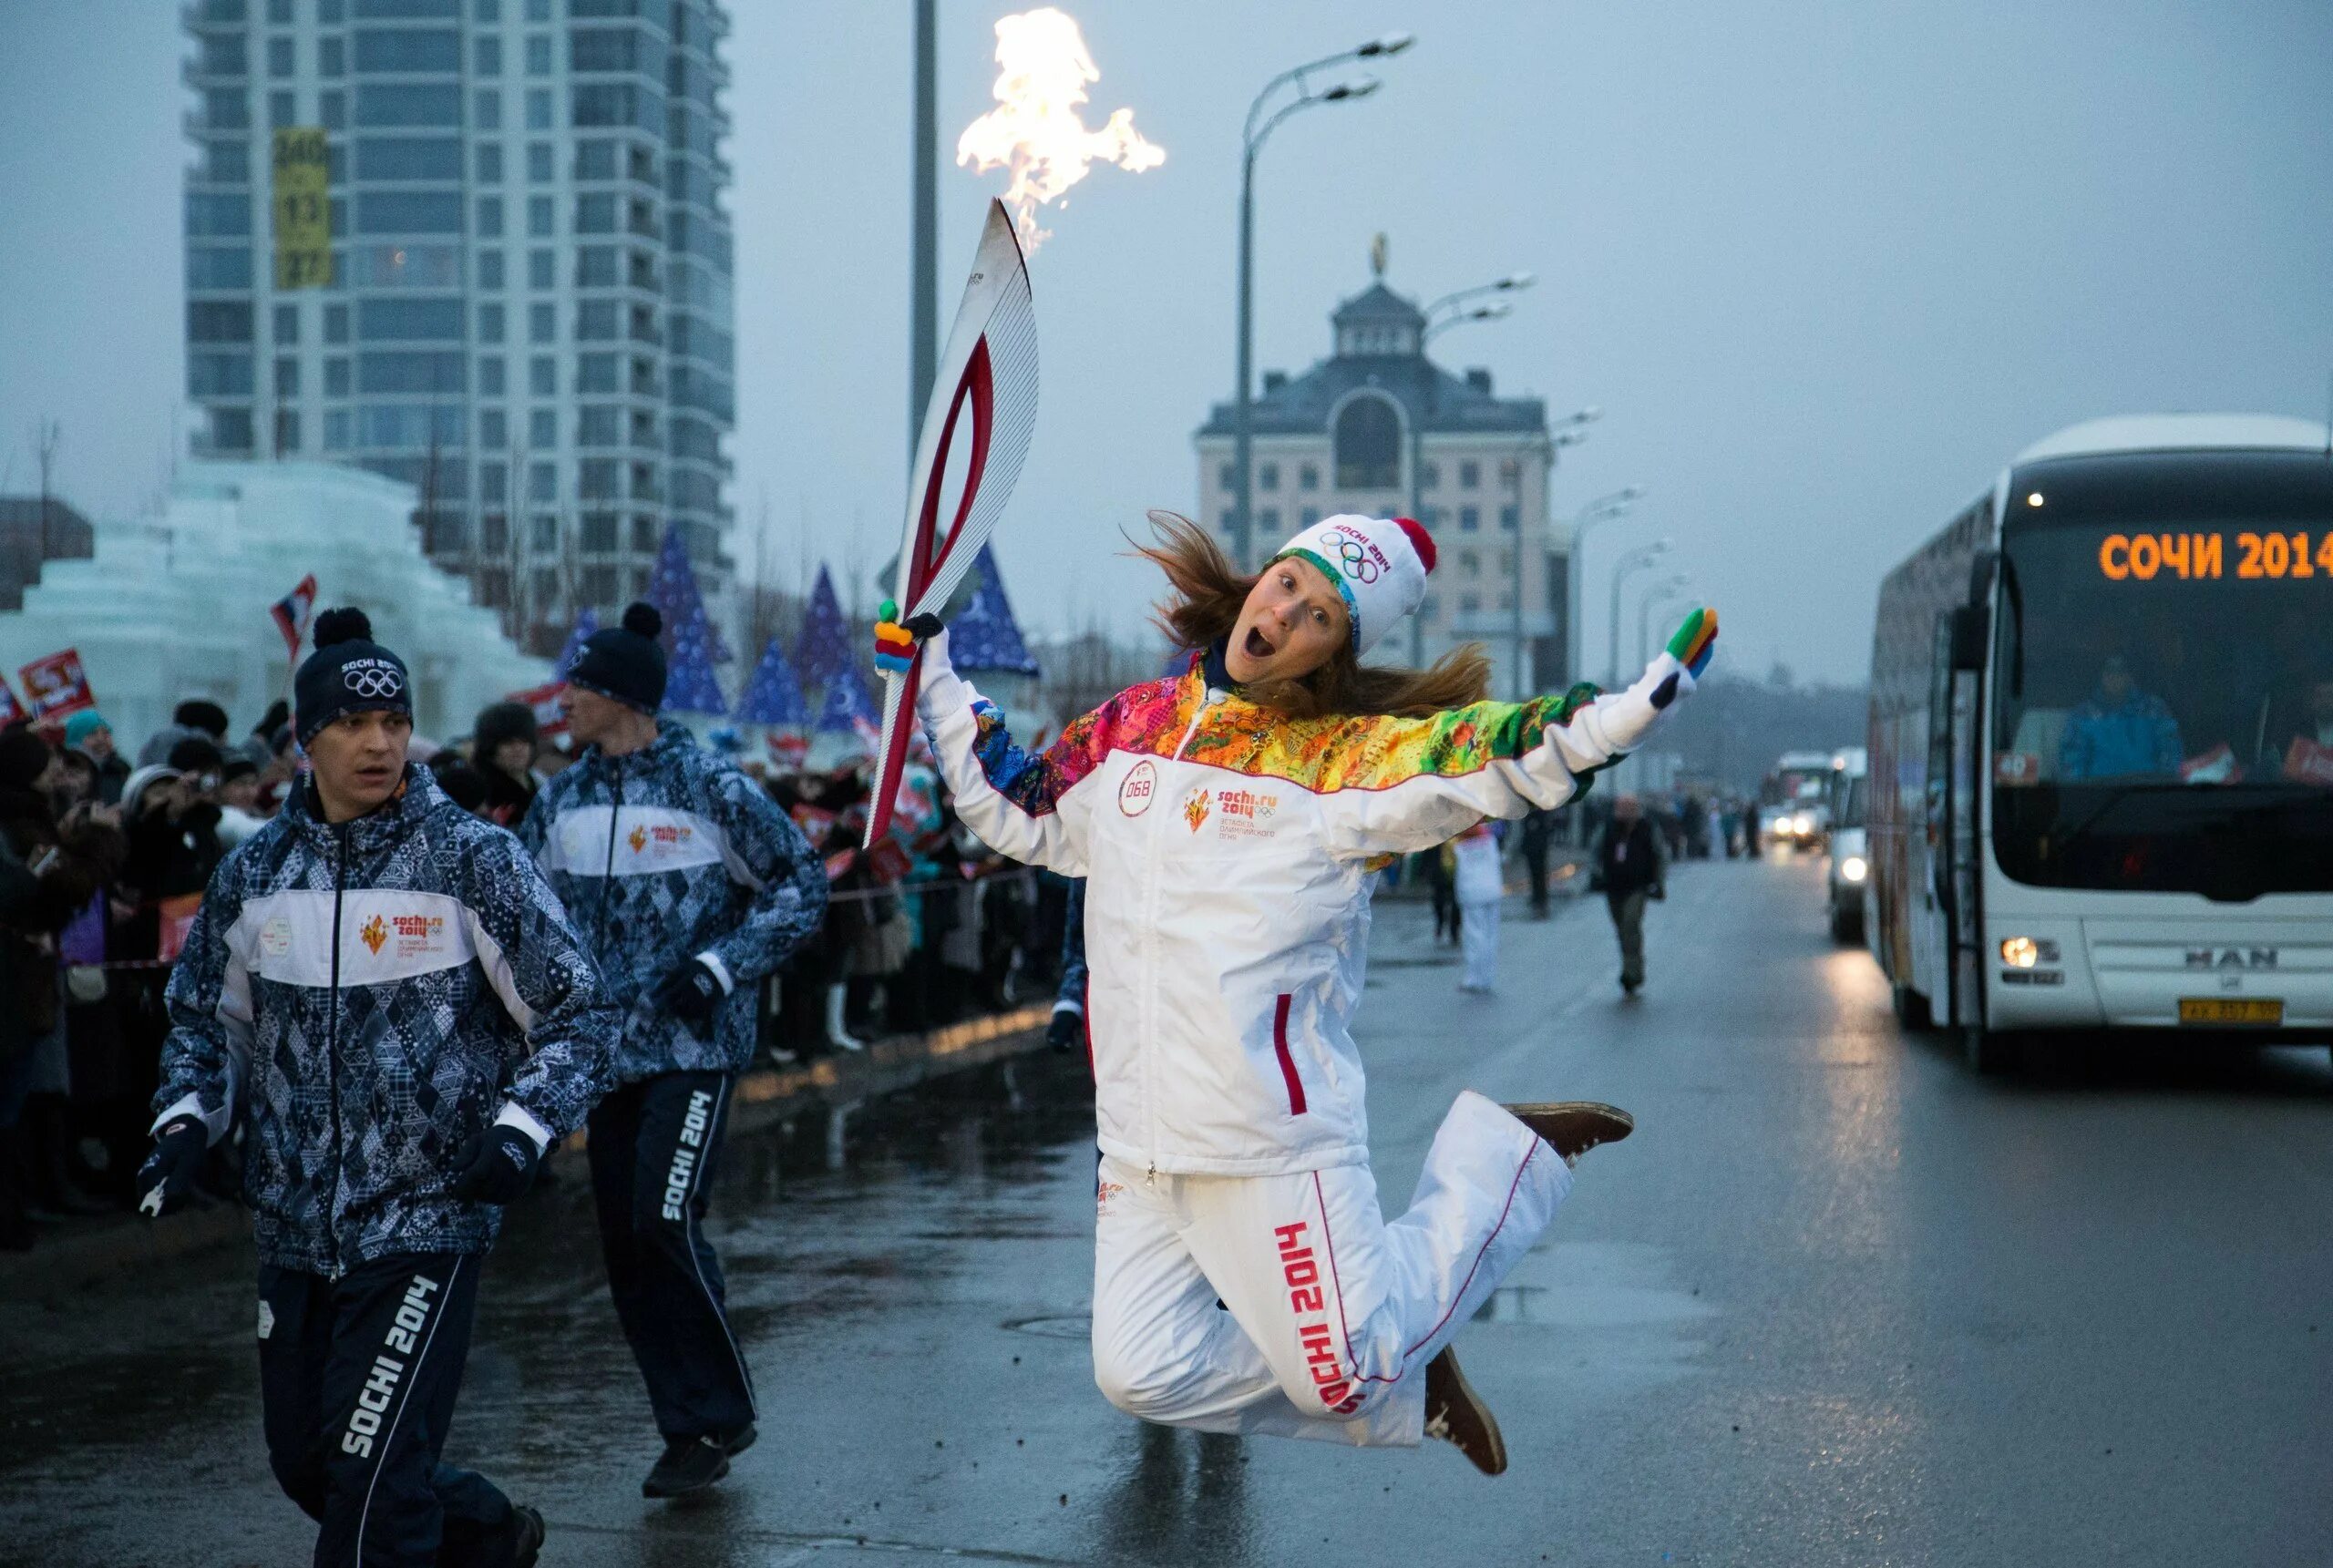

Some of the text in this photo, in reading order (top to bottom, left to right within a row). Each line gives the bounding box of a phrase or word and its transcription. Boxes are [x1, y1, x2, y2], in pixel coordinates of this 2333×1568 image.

[1333, 524, 1392, 573] SOCHI 2014
[2099, 531, 2333, 580] СОЧИ 2014
[341, 658, 375, 673] SOCHI
[1126, 780, 1151, 798] 068
[1217, 790, 1278, 807] sochi.ru
[1222, 803, 1254, 819] 2014
[393, 915, 443, 927] sochi.ru
[398, 927, 427, 938] 2014
[2185, 949, 2278, 969] MAN
[662, 1090, 713, 1221] SOCHI 2014
[1274, 1221, 1367, 1414] SOCHI 2014
[341, 1275, 438, 1459] SOCHI 2014
